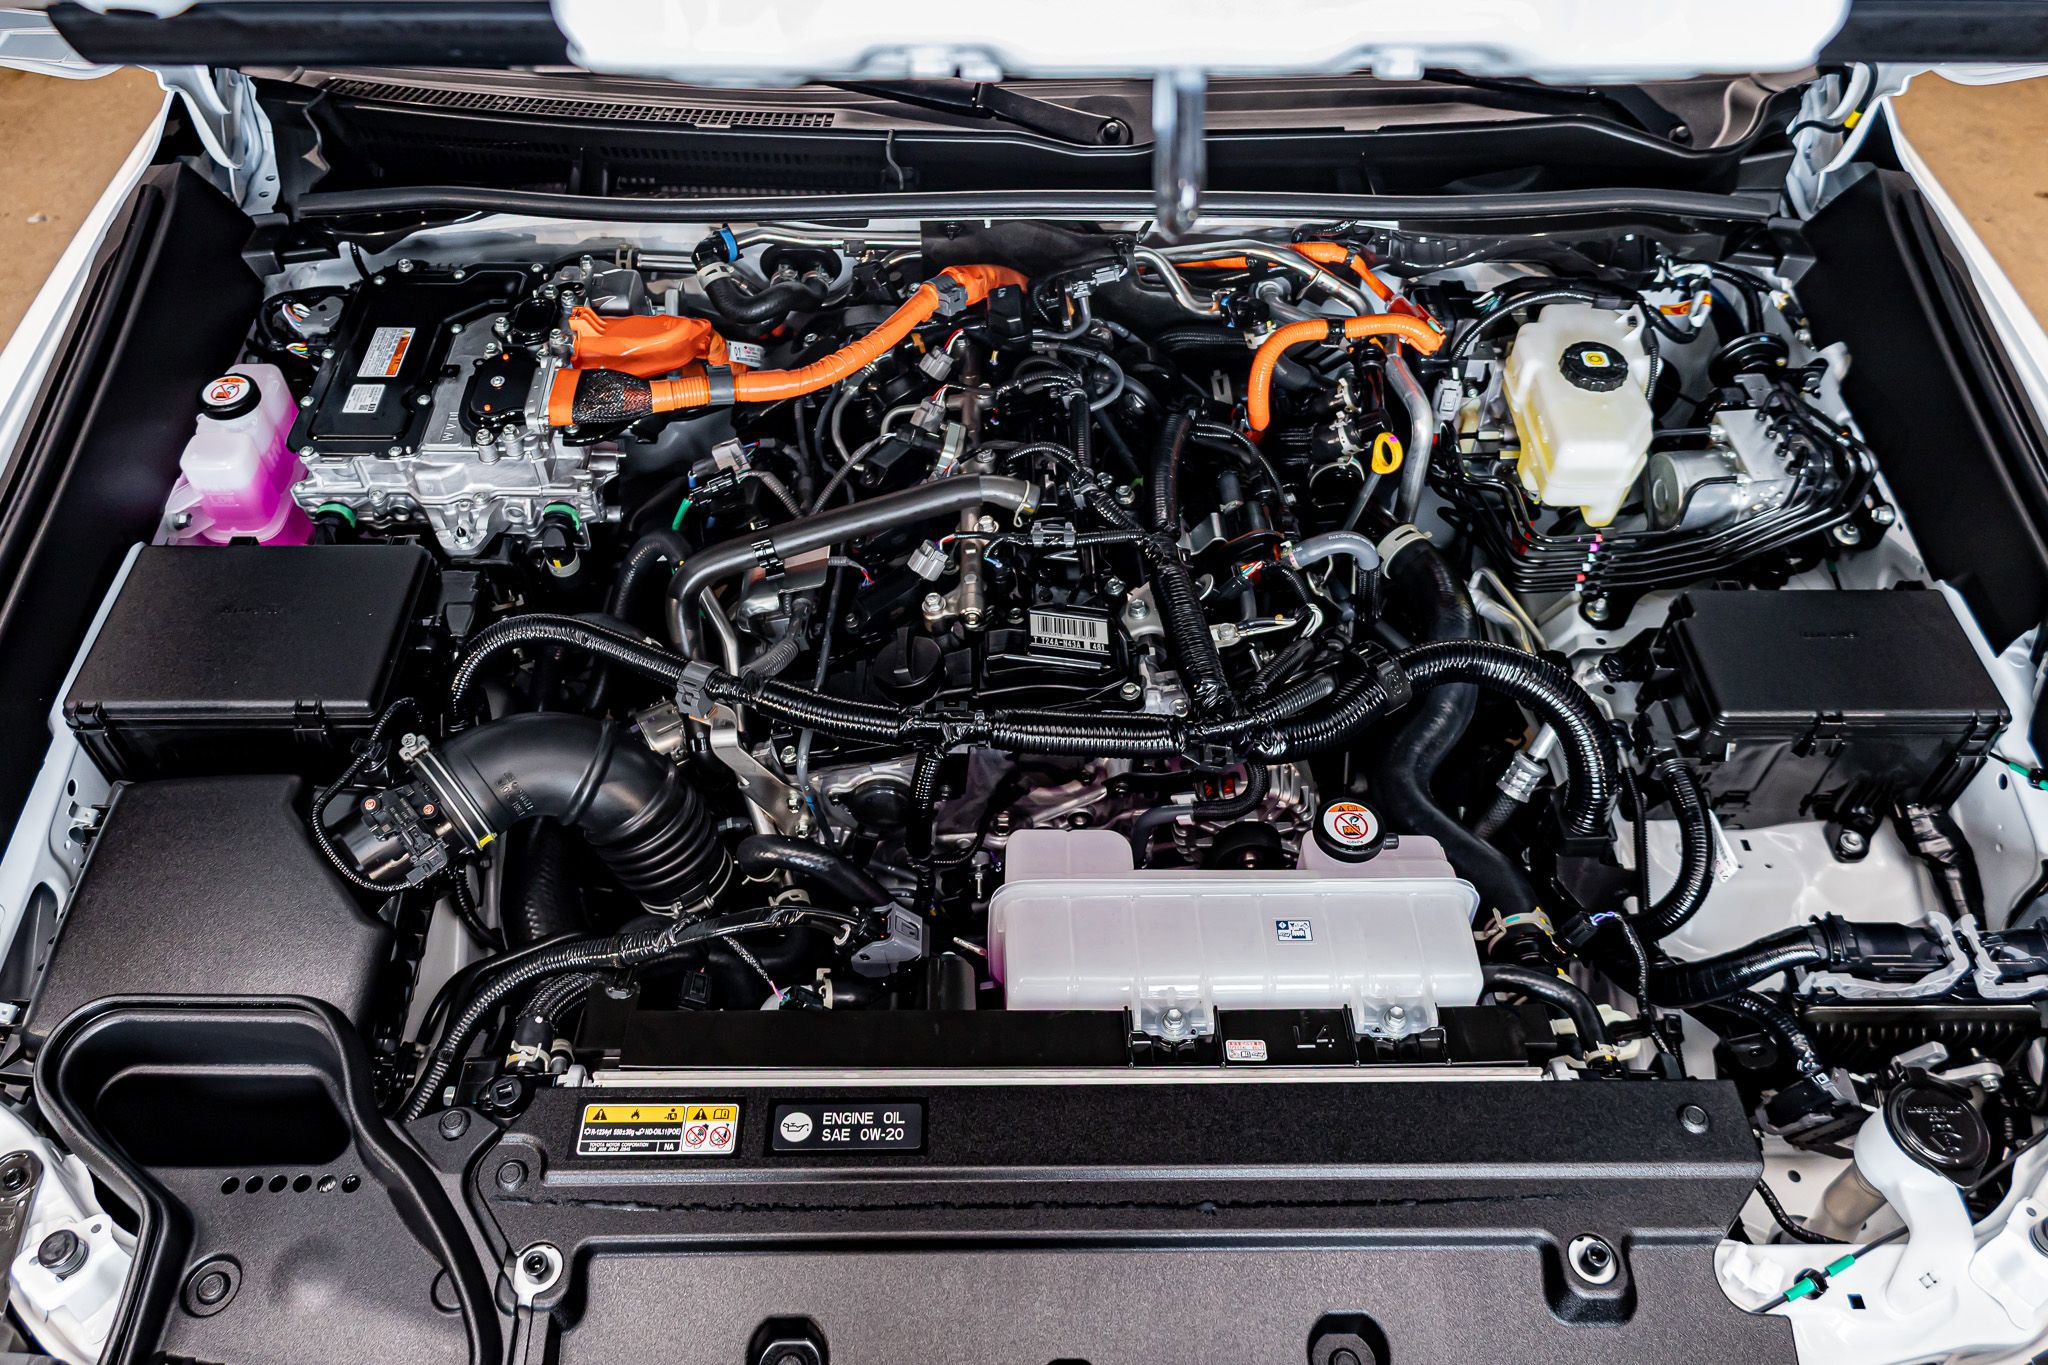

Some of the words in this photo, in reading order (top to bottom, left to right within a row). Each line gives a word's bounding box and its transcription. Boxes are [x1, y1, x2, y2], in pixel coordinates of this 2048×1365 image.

[822, 1112, 874, 1125] ENGINE
[883, 1111, 905, 1125] OIL
[821, 1128, 850, 1142] SAE
[860, 1127, 904, 1141] 0W-20
[663, 1143, 674, 1151] NA
